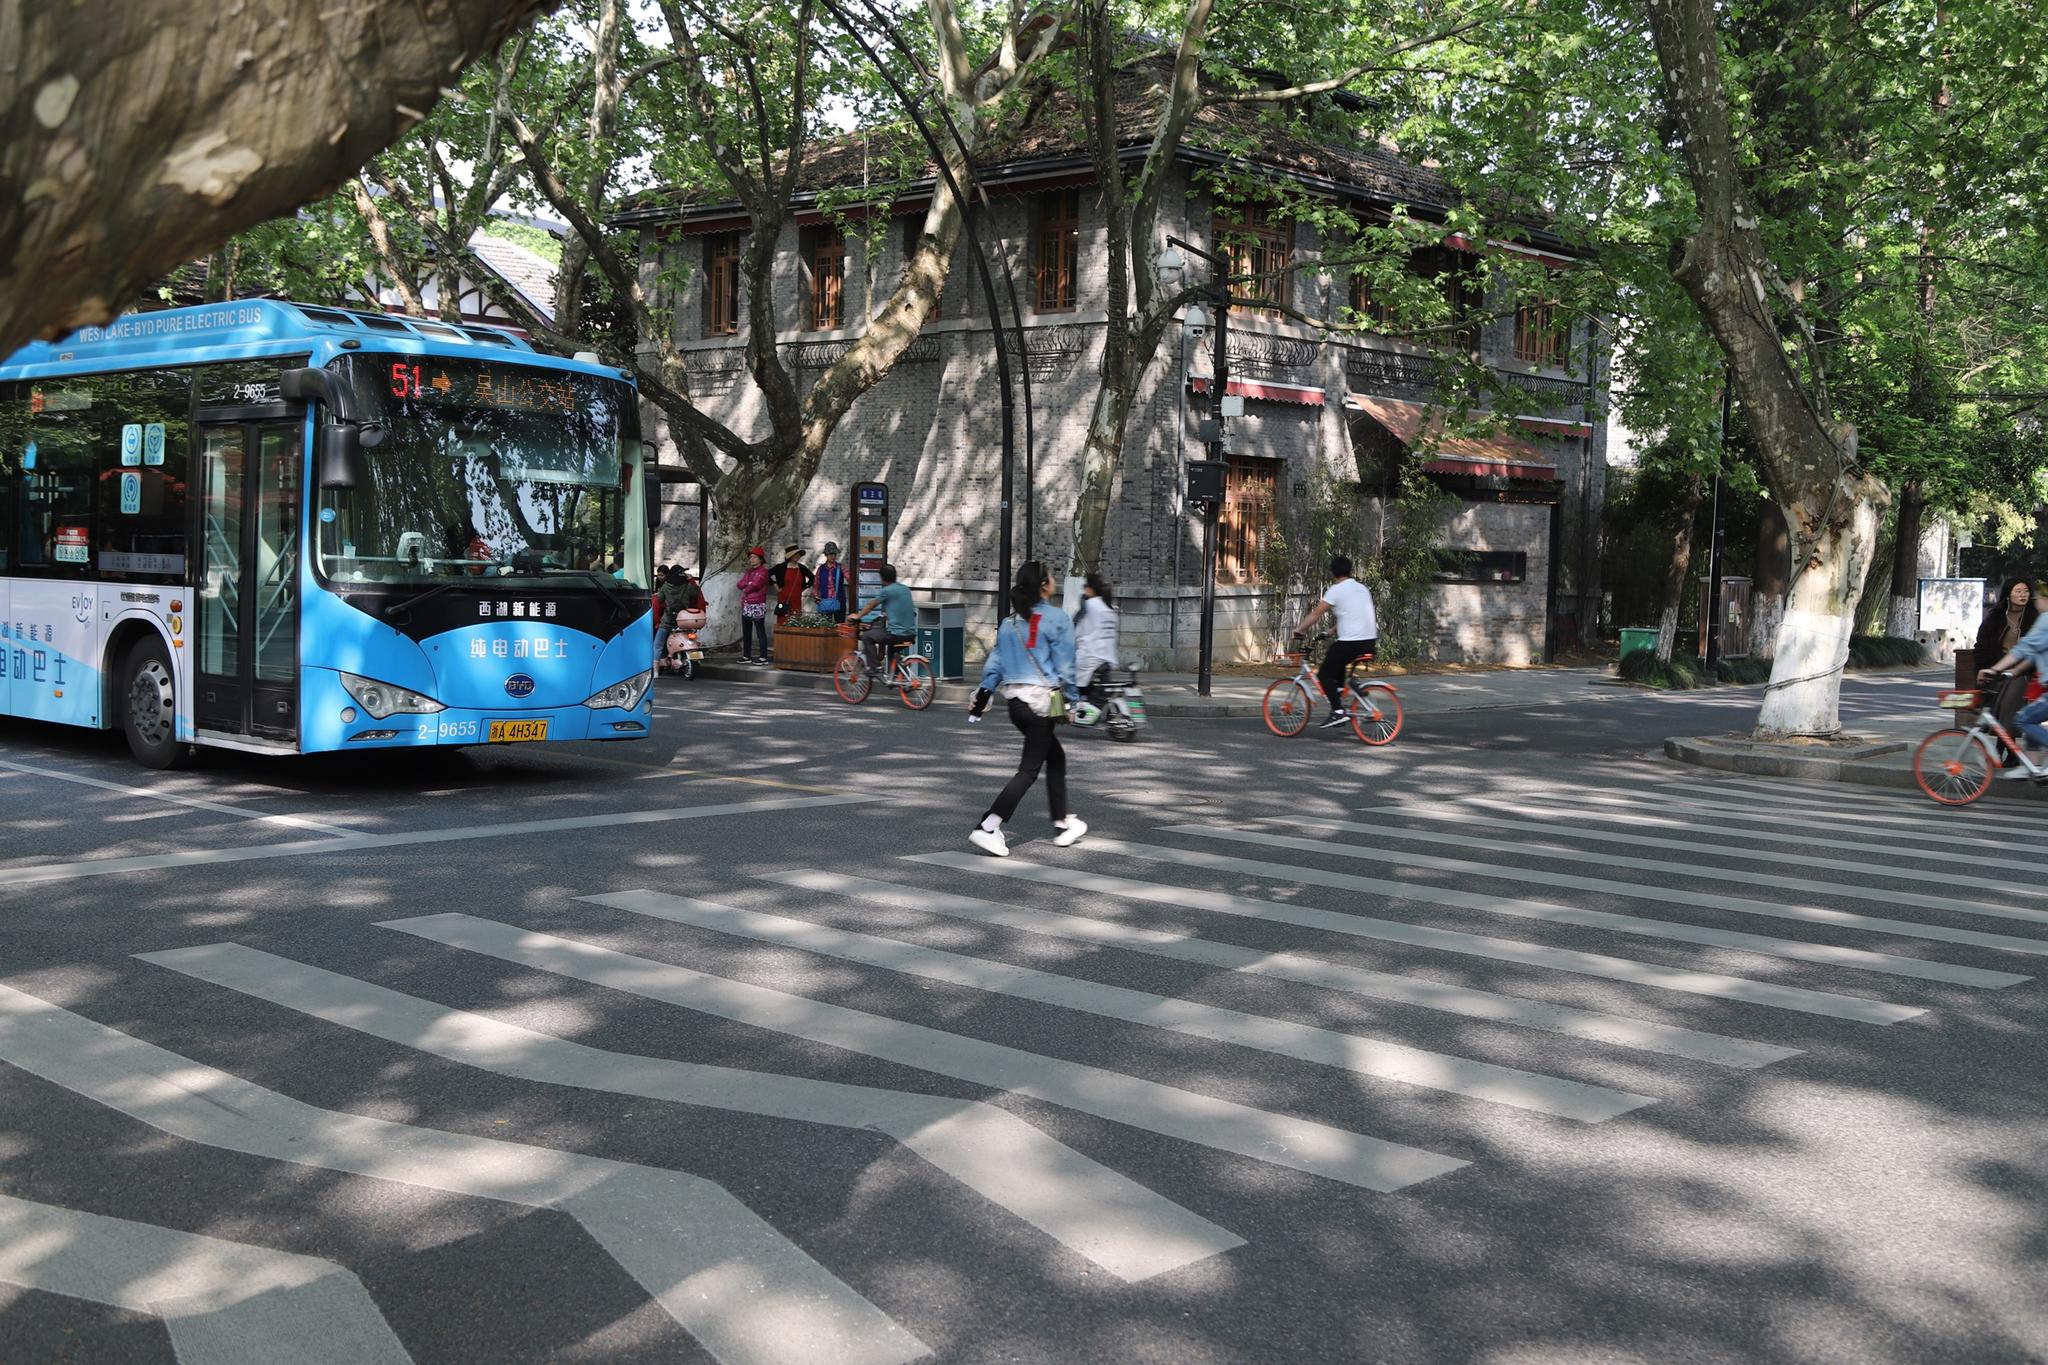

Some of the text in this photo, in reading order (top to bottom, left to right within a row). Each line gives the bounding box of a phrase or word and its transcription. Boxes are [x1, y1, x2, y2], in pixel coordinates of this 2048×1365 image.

[156, 317, 183, 332] PURE
[185, 310, 236, 330] ELECTRIC
[239, 307, 262, 324] BUS
[233, 383, 267, 399] 2-9655
[391, 363, 422, 400] 51
[479, 601, 557, 617] 西湖新能源
[470, 638, 569, 658] 纯电动巴士
[508, 680, 532, 691] BYD
[417, 720, 477, 740] 2-9655
